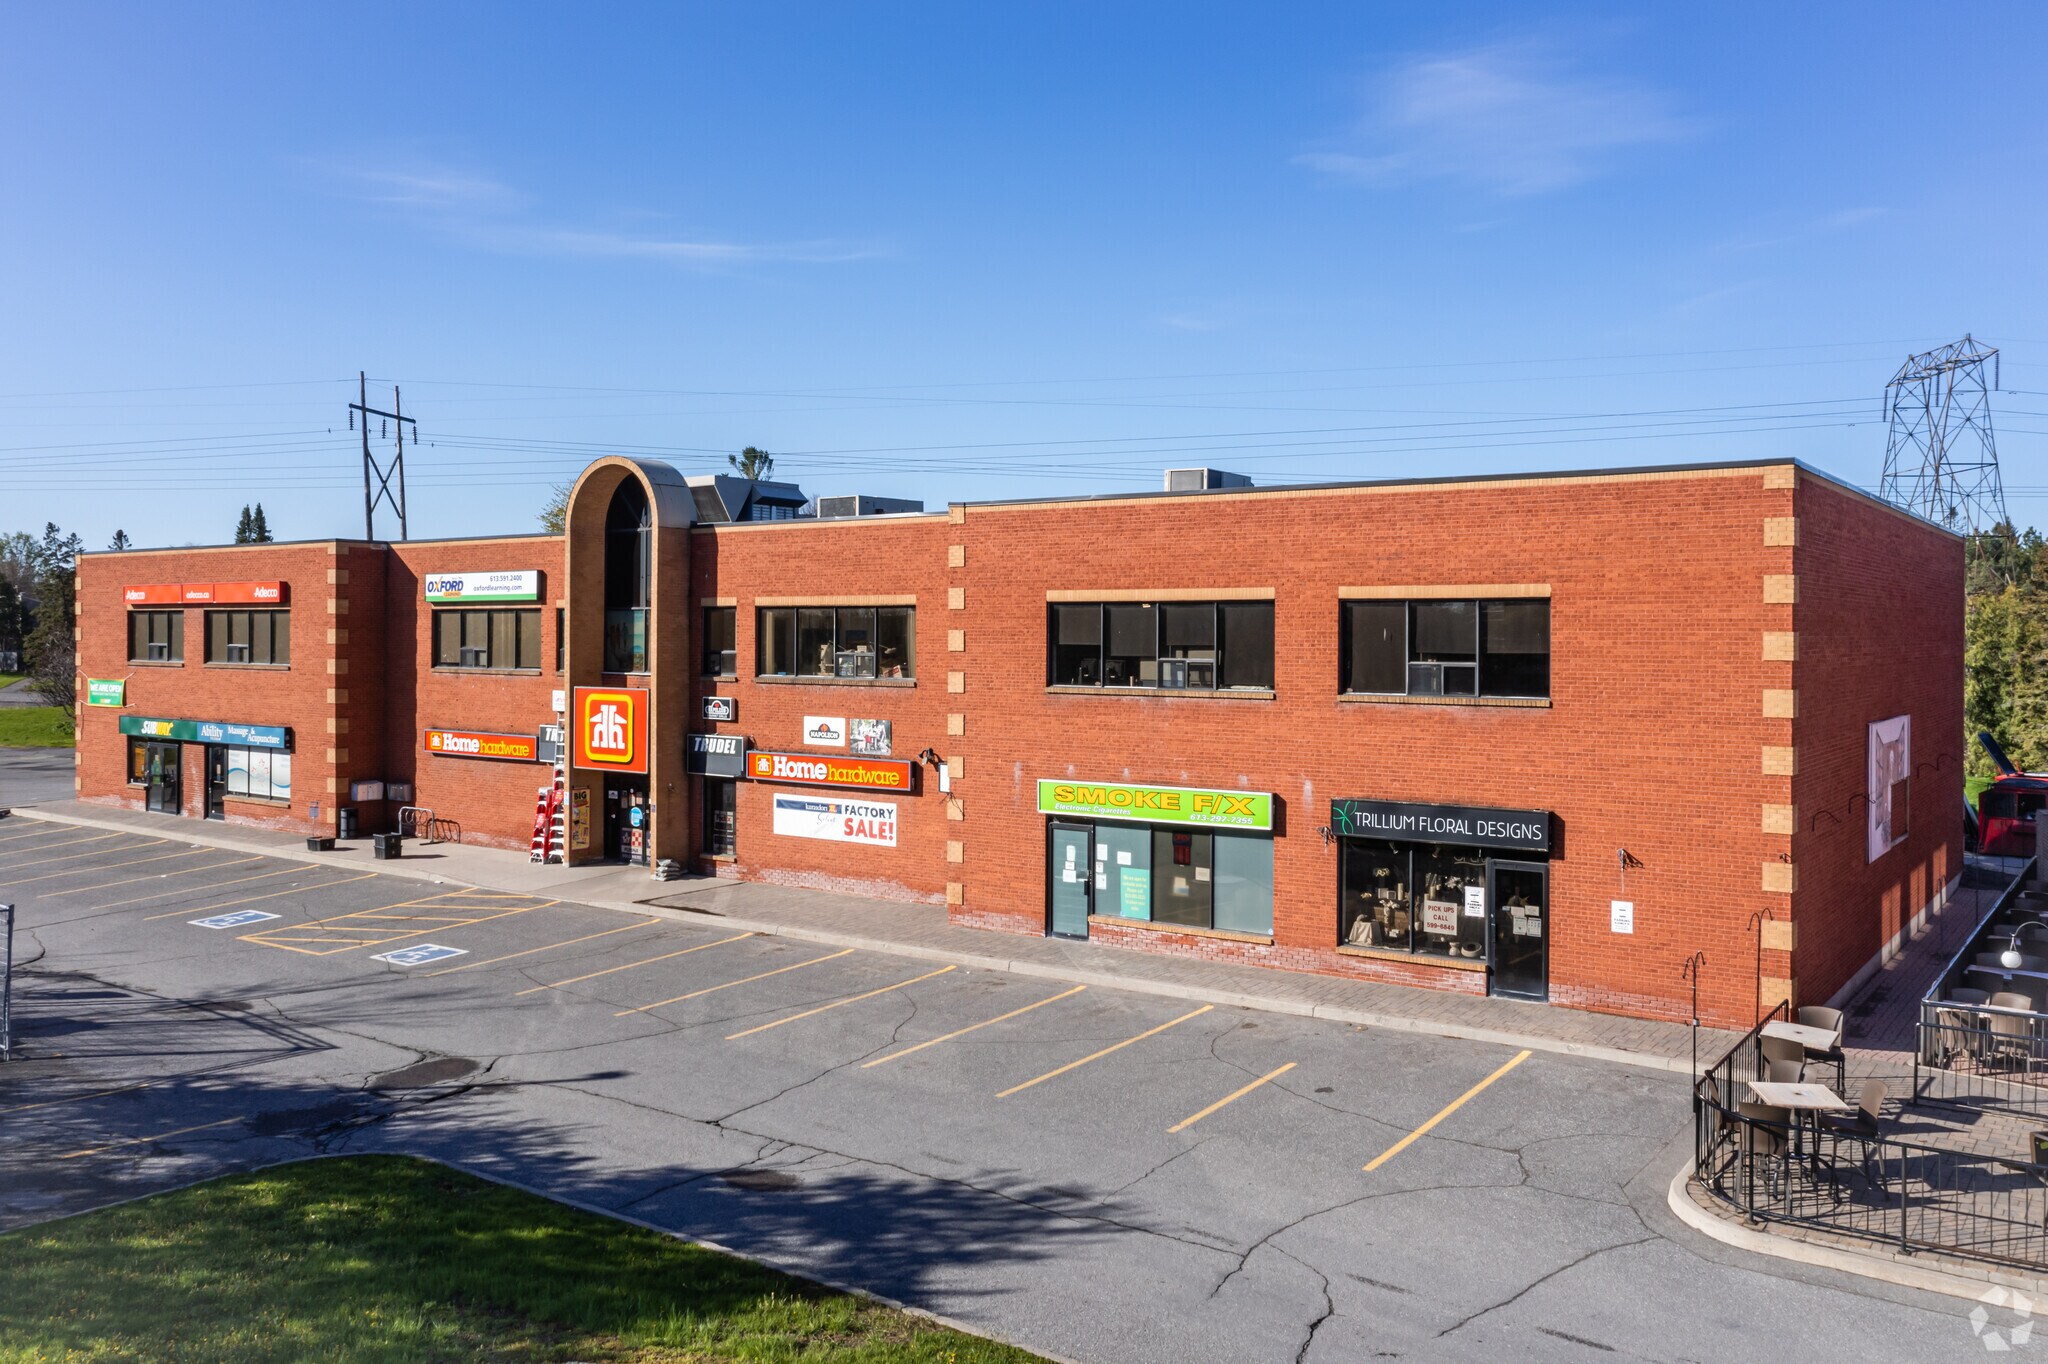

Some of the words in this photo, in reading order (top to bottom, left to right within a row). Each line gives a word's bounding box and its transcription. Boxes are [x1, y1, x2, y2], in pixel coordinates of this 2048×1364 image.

[427, 578, 464, 593] OXFORD
[489, 574, 523, 582] 613.591.2400
[126, 590, 146, 600] Adecco
[254, 587, 278, 598] Adecco
[473, 584, 523, 593] oxfordlearning.com
[141, 721, 174, 736] SUBWAY
[201, 725, 223, 741] Ability
[809, 731, 839, 739] NAPOLEON
[247, 733, 280, 744] Acupuncture
[442, 733, 480, 753] Home
[480, 739, 530, 756] hardware
[694, 737, 736, 754] TRUDEL
[773, 756, 828, 780] Home
[828, 764, 900, 785] hardware
[573, 791, 587, 800] BIG
[1053, 785, 1181, 811] SMOKE
[1193, 794, 1256, 816] F/X
[844, 804, 894, 819] FACTORY
[1054, 803, 1092, 813] Electronic
[1093, 805, 1131, 816] Cigarettes
[1190, 813, 1253, 825] 613-297-7355
[1355, 811, 1415, 830] TRILLIUM
[1419, 816, 1473, 835] FLORAL
[1477, 819, 1542, 840] DESIGNS
[843, 817, 894, 841] SALE!
